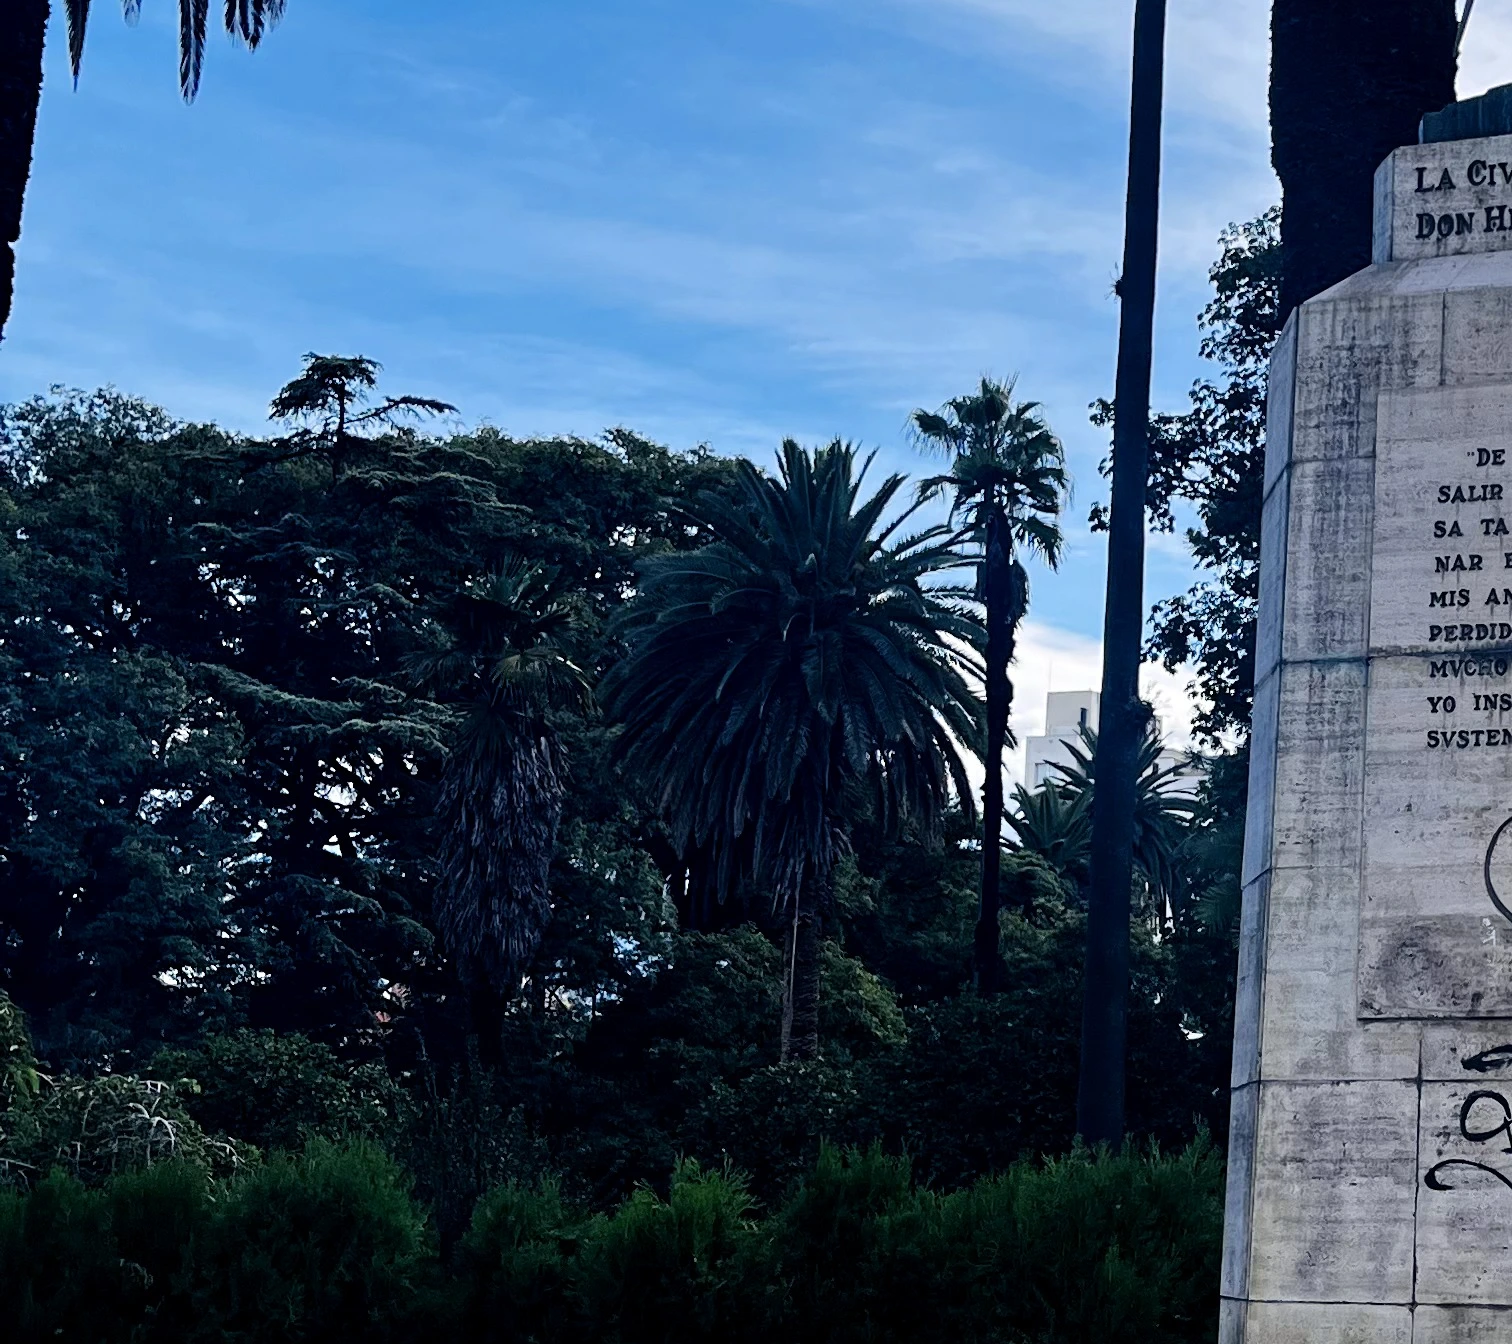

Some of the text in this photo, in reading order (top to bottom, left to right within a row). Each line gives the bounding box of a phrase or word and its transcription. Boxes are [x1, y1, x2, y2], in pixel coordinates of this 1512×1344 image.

[1415, 166, 1456, 193] LA
[1415, 212, 1474, 240] DON
[1437, 484, 1504, 504] SALIR
[1434, 519, 1463, 538] SA
[1434, 554, 1483, 573] NAR
[1429, 588, 1470, 608] MIS
[1429, 658, 1508, 678] MVCHO
[1427, 695, 1456, 714] YO
